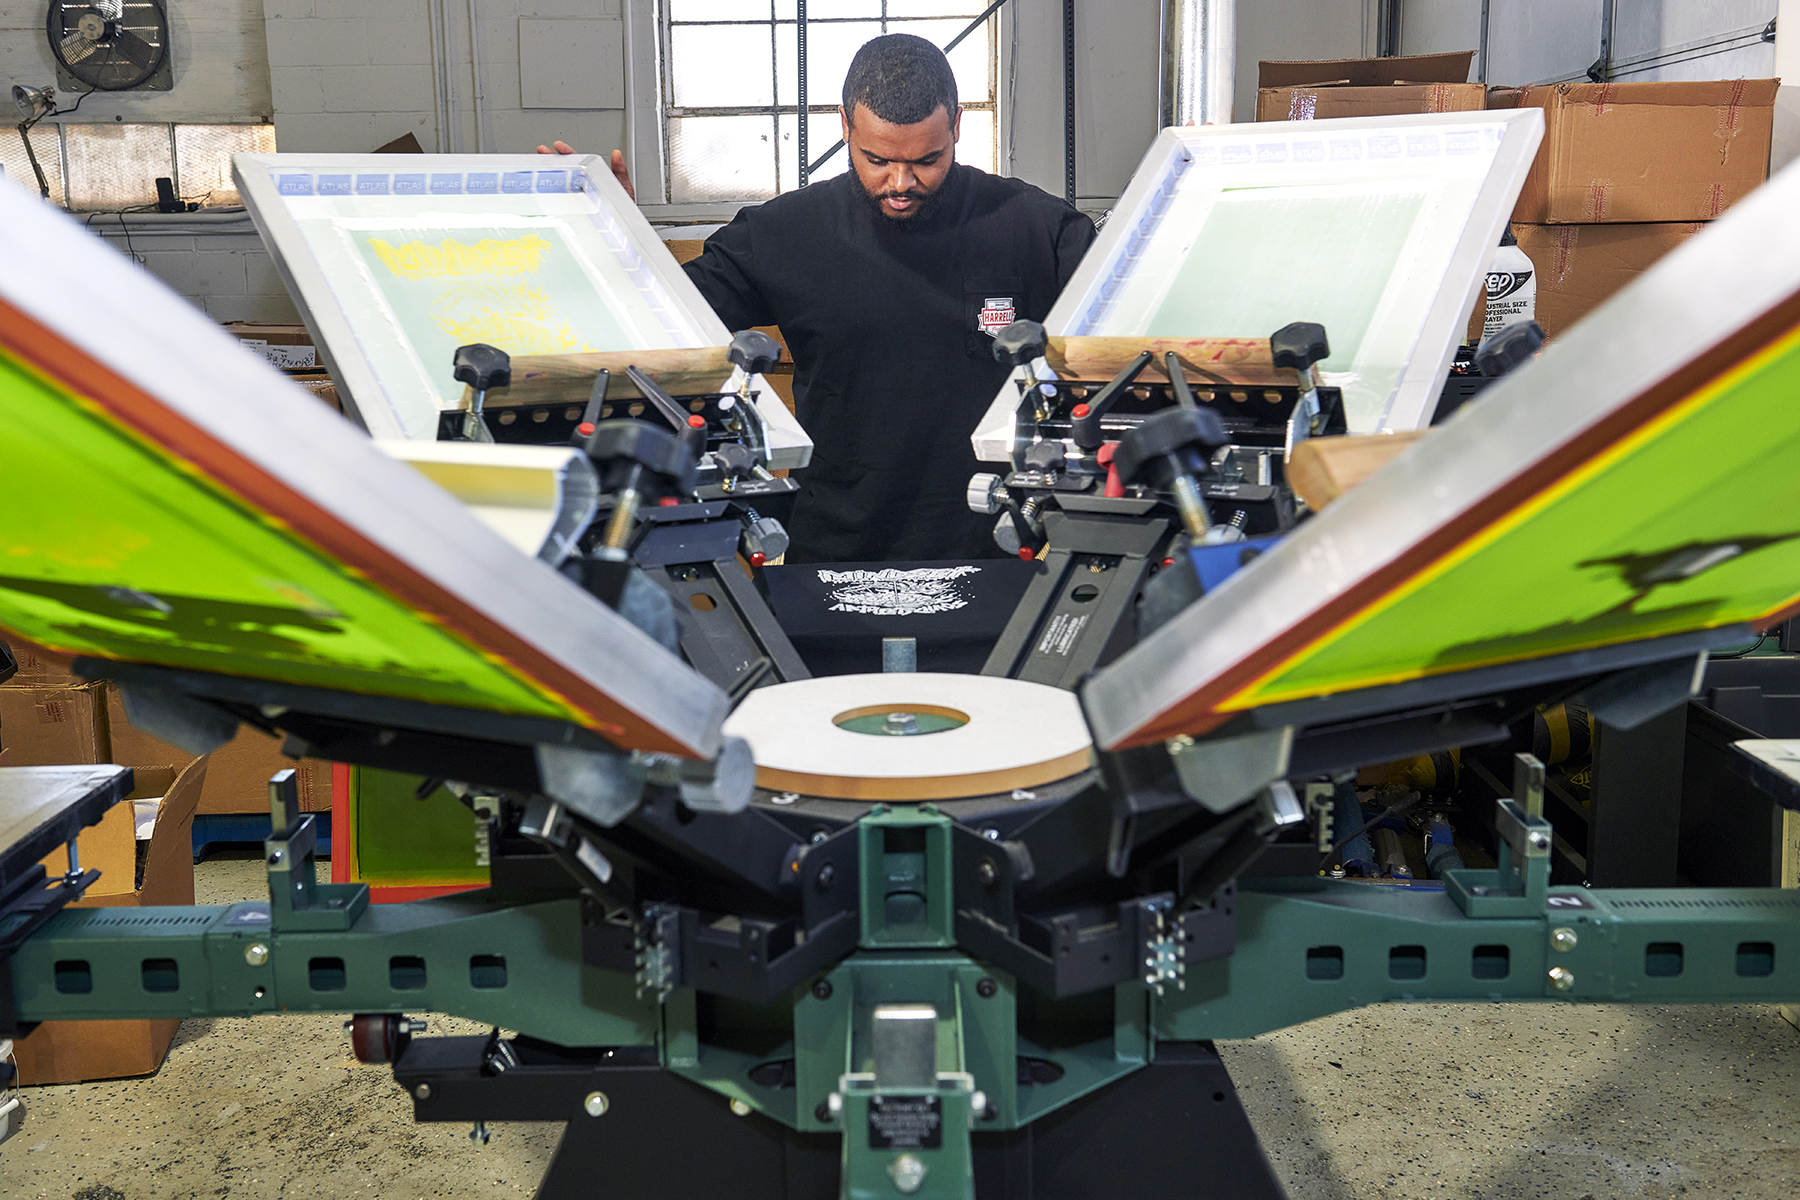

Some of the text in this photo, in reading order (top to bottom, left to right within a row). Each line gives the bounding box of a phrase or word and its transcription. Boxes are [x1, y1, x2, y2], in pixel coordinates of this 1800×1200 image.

[1296, 148, 1323, 157] ATLAS
[1449, 141, 1477, 150] ATLAS
[282, 182, 311, 192] ATLAS
[321, 182, 349, 191] ATLAS
[359, 182, 386, 190] ATLAS
[396, 181, 423, 190] ATLAS
[433, 181, 460, 189] ATLAS
[469, 180, 495, 188] ATLAS
[504, 180, 531, 188] ATLAS
[539, 179, 565, 187] ATLAS
[366, 233, 553, 281] MINDSET
